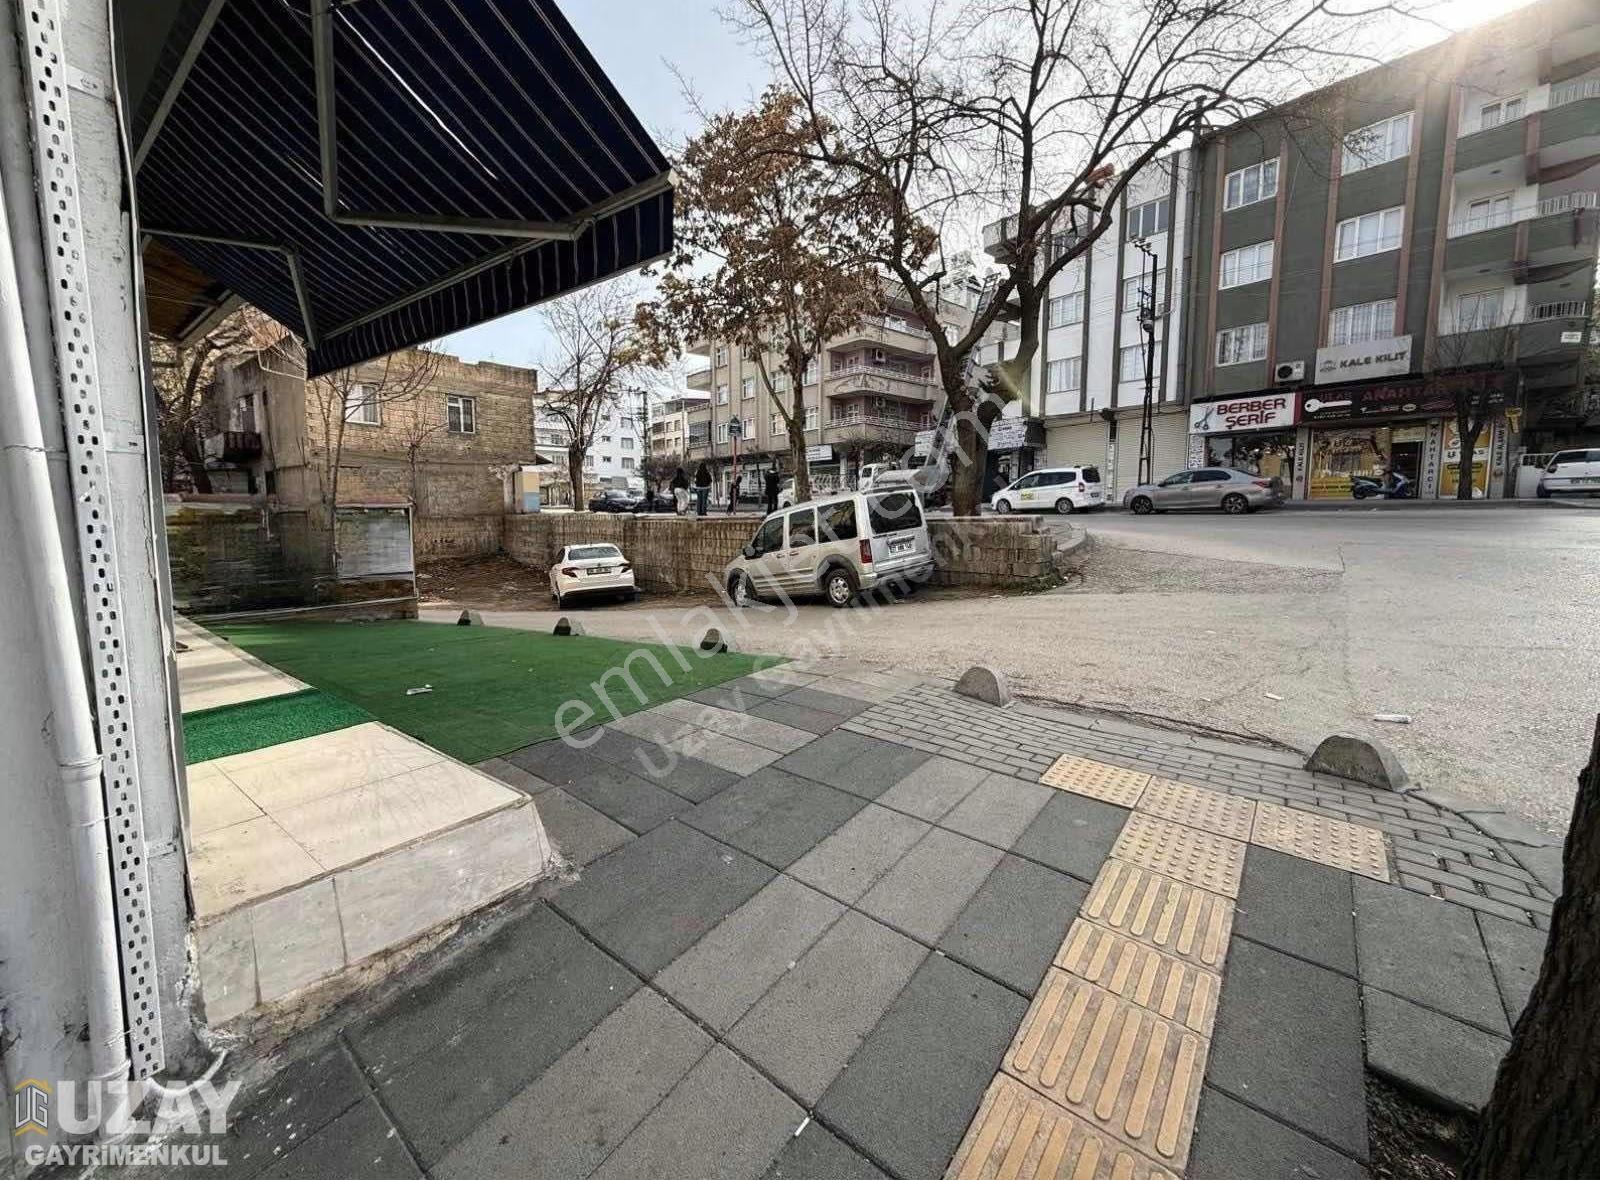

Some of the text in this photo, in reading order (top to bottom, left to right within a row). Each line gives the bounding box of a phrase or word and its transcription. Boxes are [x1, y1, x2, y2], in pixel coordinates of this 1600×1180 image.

[1339, 356, 1372, 369] KALE
[1217, 397, 1287, 415] BERBER
[1225, 410, 1277, 430] ŞERİF
